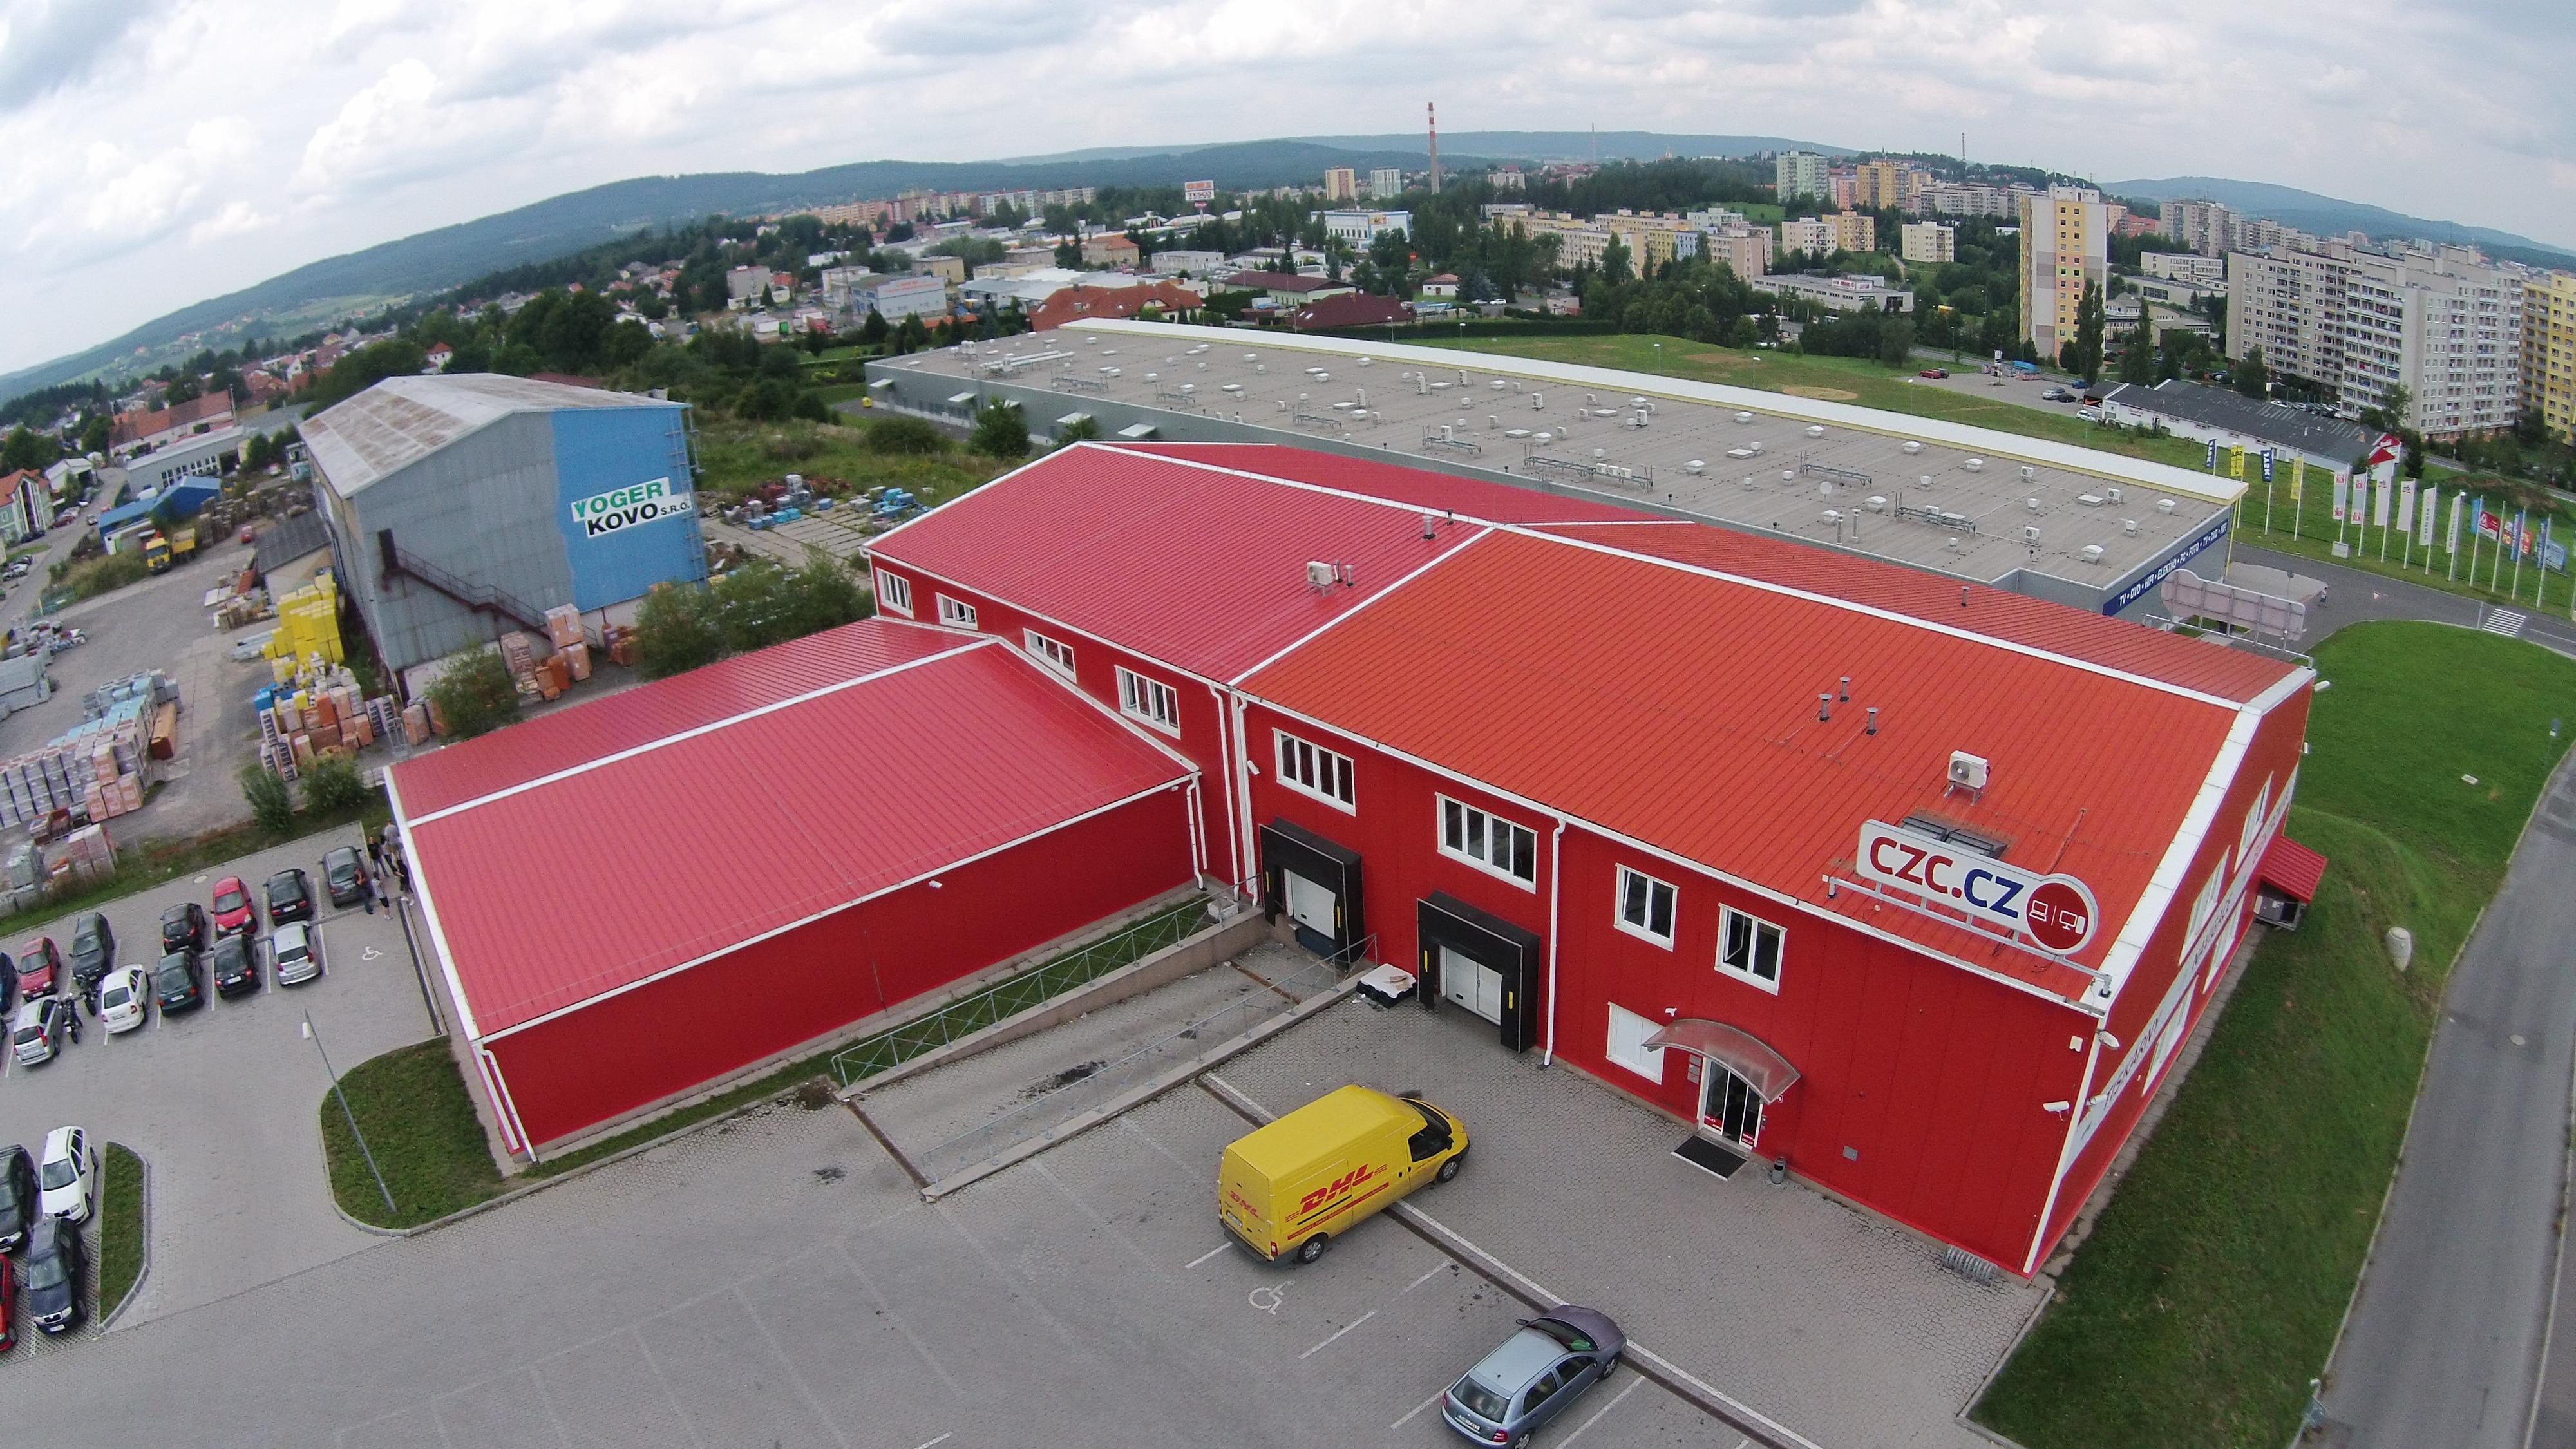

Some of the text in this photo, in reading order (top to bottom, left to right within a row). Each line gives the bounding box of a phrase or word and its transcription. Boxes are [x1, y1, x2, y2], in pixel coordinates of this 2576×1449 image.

[587, 503, 658, 535] KOVO
[2120, 593, 2126, 606] TV
[2130, 584, 2141, 600] DVD
[2180, 552, 2186, 564] PC
[2203, 536, 2209, 546] TV
[1870, 837, 2024, 919] CZC.CZ
[1230, 1190, 1259, 1218] DHL
[1300, 1164, 1374, 1216] DHL
